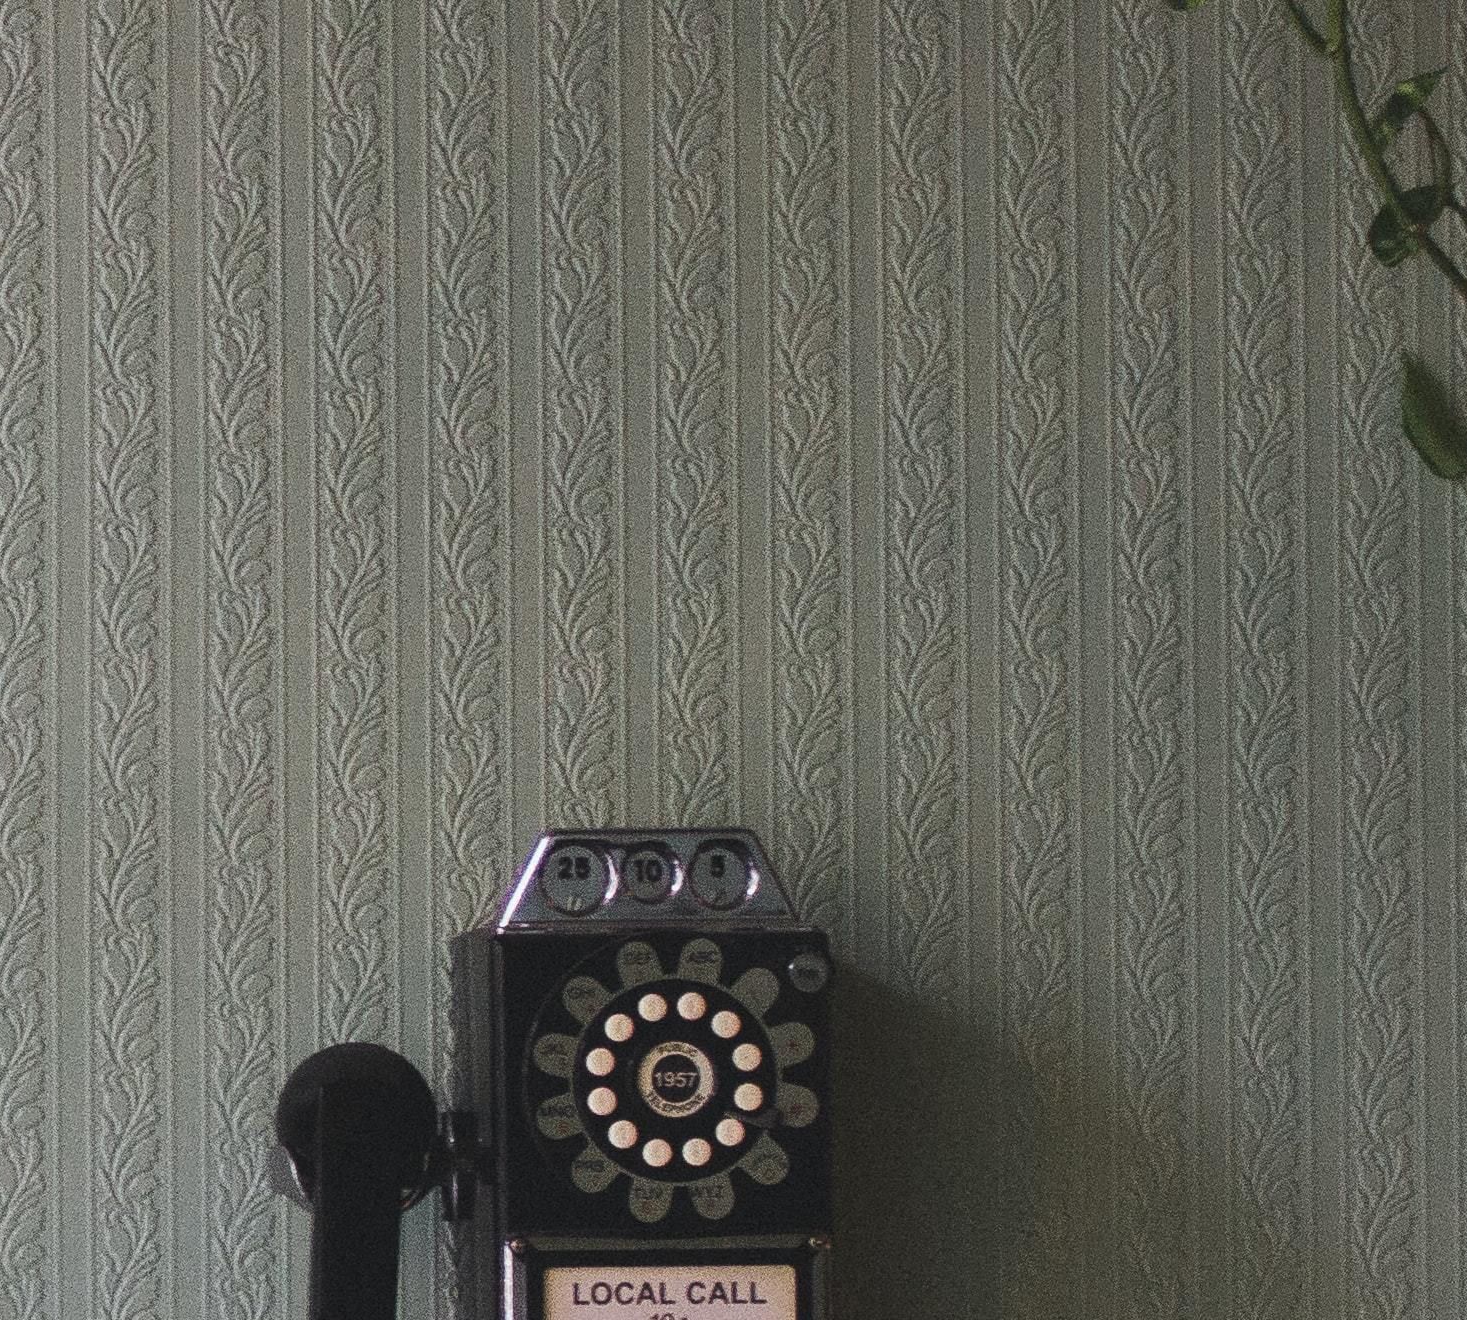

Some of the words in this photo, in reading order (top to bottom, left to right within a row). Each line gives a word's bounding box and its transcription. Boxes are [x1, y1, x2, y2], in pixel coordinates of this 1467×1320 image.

[558, 857, 591, 879] 25
[636, 860, 663, 882] 10
[710, 855, 725, 878] 5
[654, 1071, 697, 1088] 1957
[572, 1281, 676, 1305] LOCAL
[686, 1281, 768, 1304] CALL
